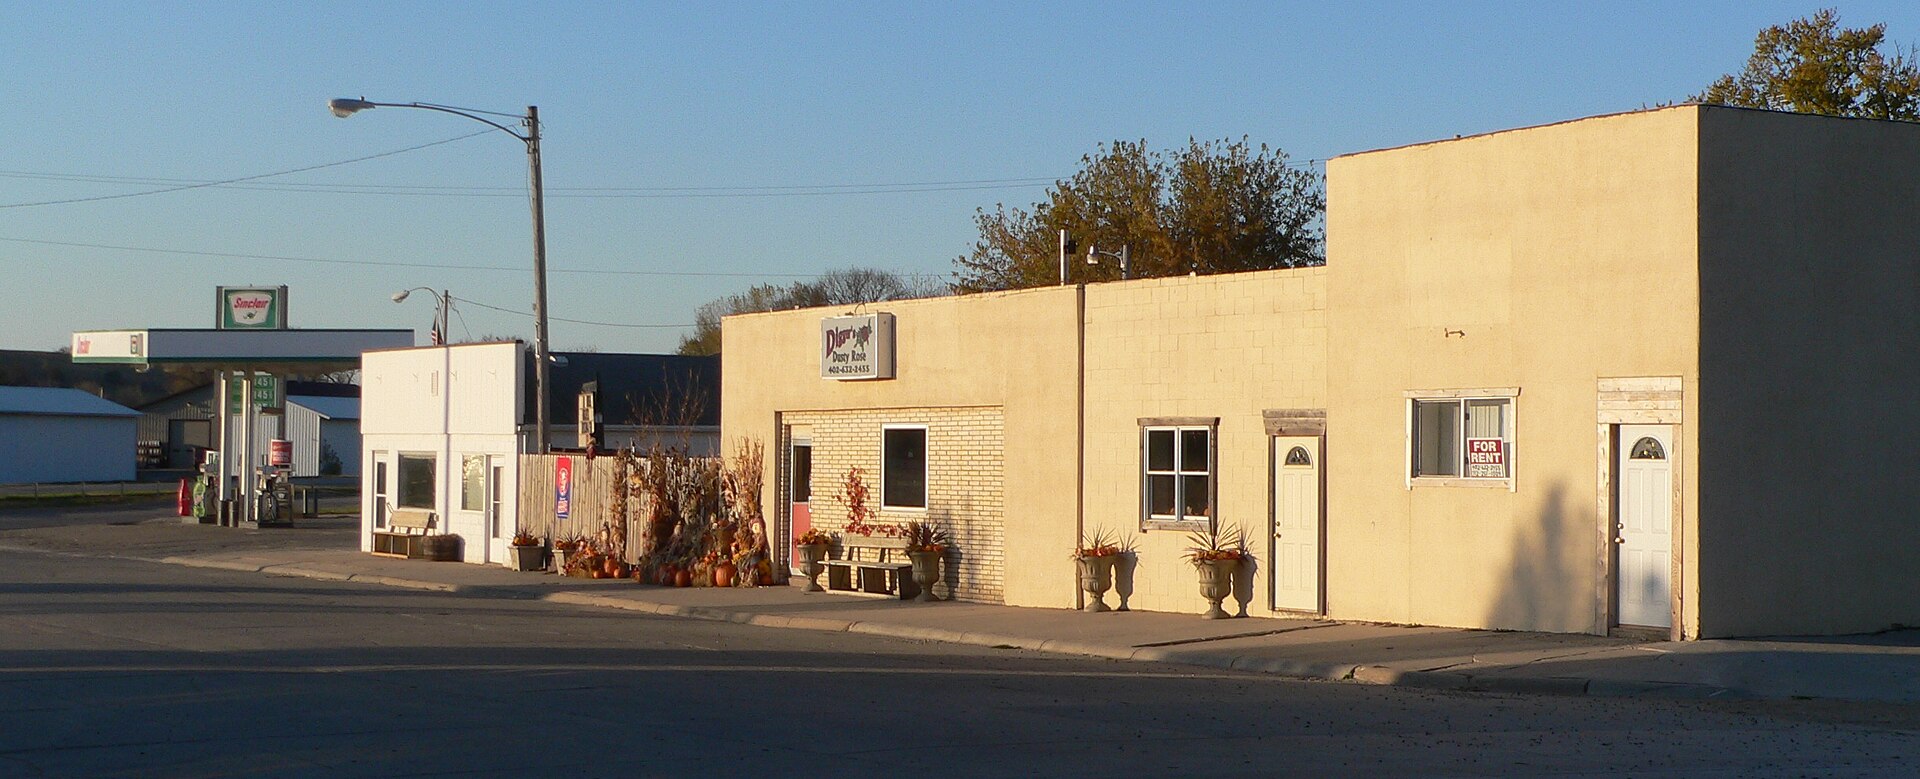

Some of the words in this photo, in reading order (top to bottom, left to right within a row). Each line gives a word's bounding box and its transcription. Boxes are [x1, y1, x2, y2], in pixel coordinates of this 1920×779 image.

[234, 297, 269, 309] Sinclair
[832, 351, 849, 364] Dusty
[851, 350, 866, 362] Rose
[1473, 441, 1497, 452] FOR
[1471, 452, 1501, 463] RENT
